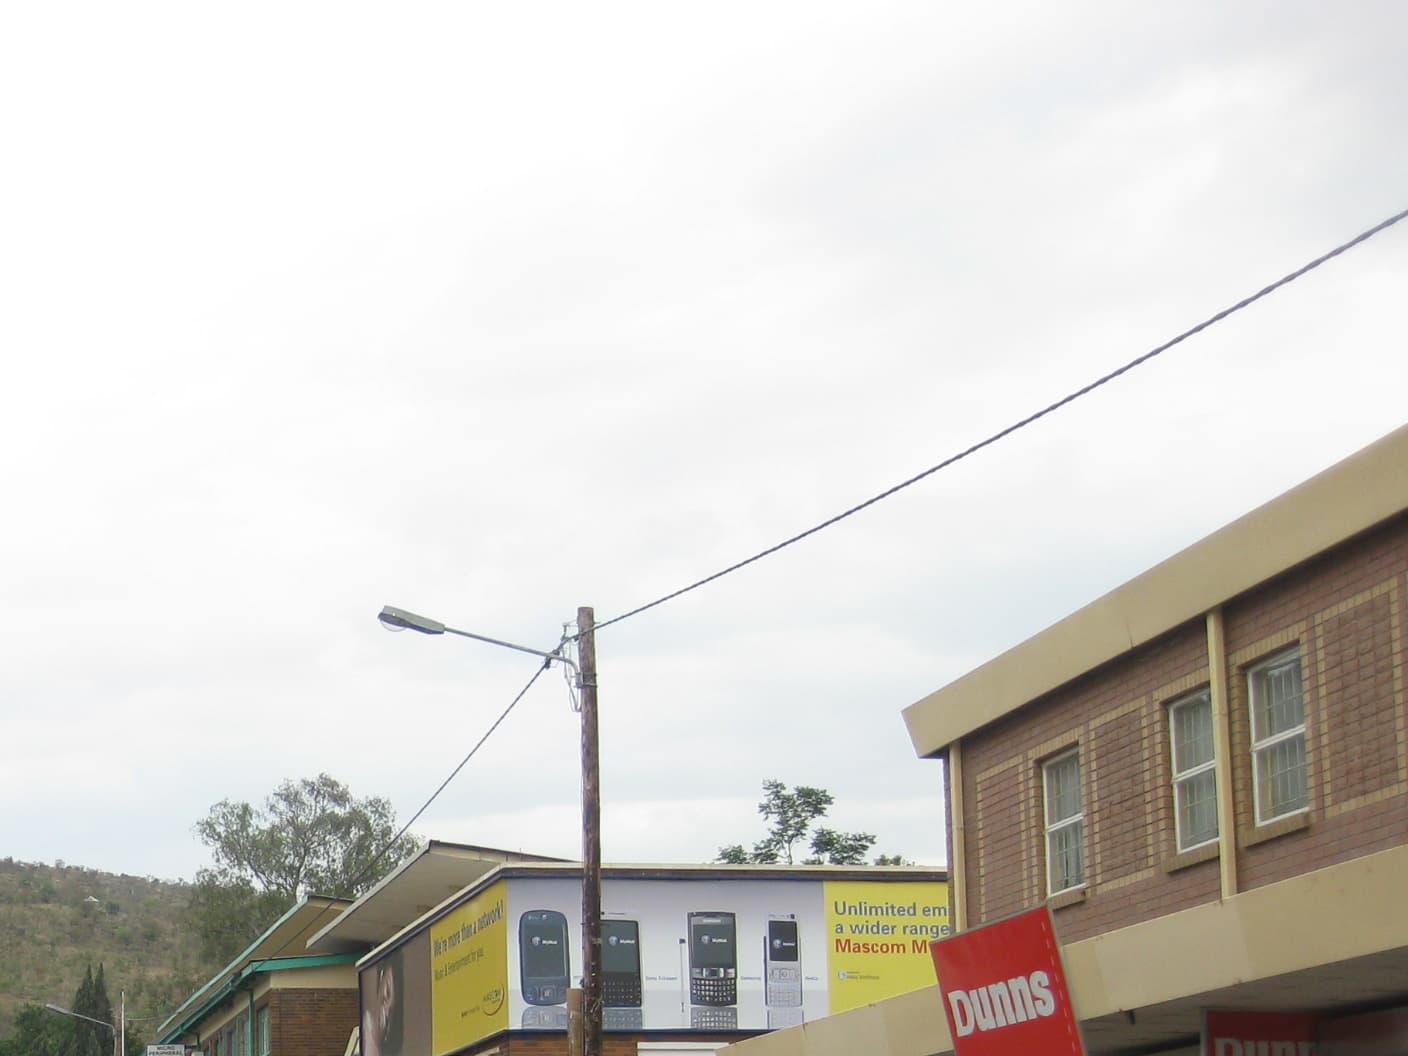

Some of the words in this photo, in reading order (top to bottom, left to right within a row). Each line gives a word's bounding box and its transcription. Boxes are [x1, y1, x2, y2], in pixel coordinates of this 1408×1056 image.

[834, 901, 917, 917] Unlimited
[835, 923, 844, 934] a
[849, 920, 897, 935] wider
[903, 924, 950, 939] range
[835, 939, 906, 954] Mascom
[947, 970, 1055, 1038] Dunns
